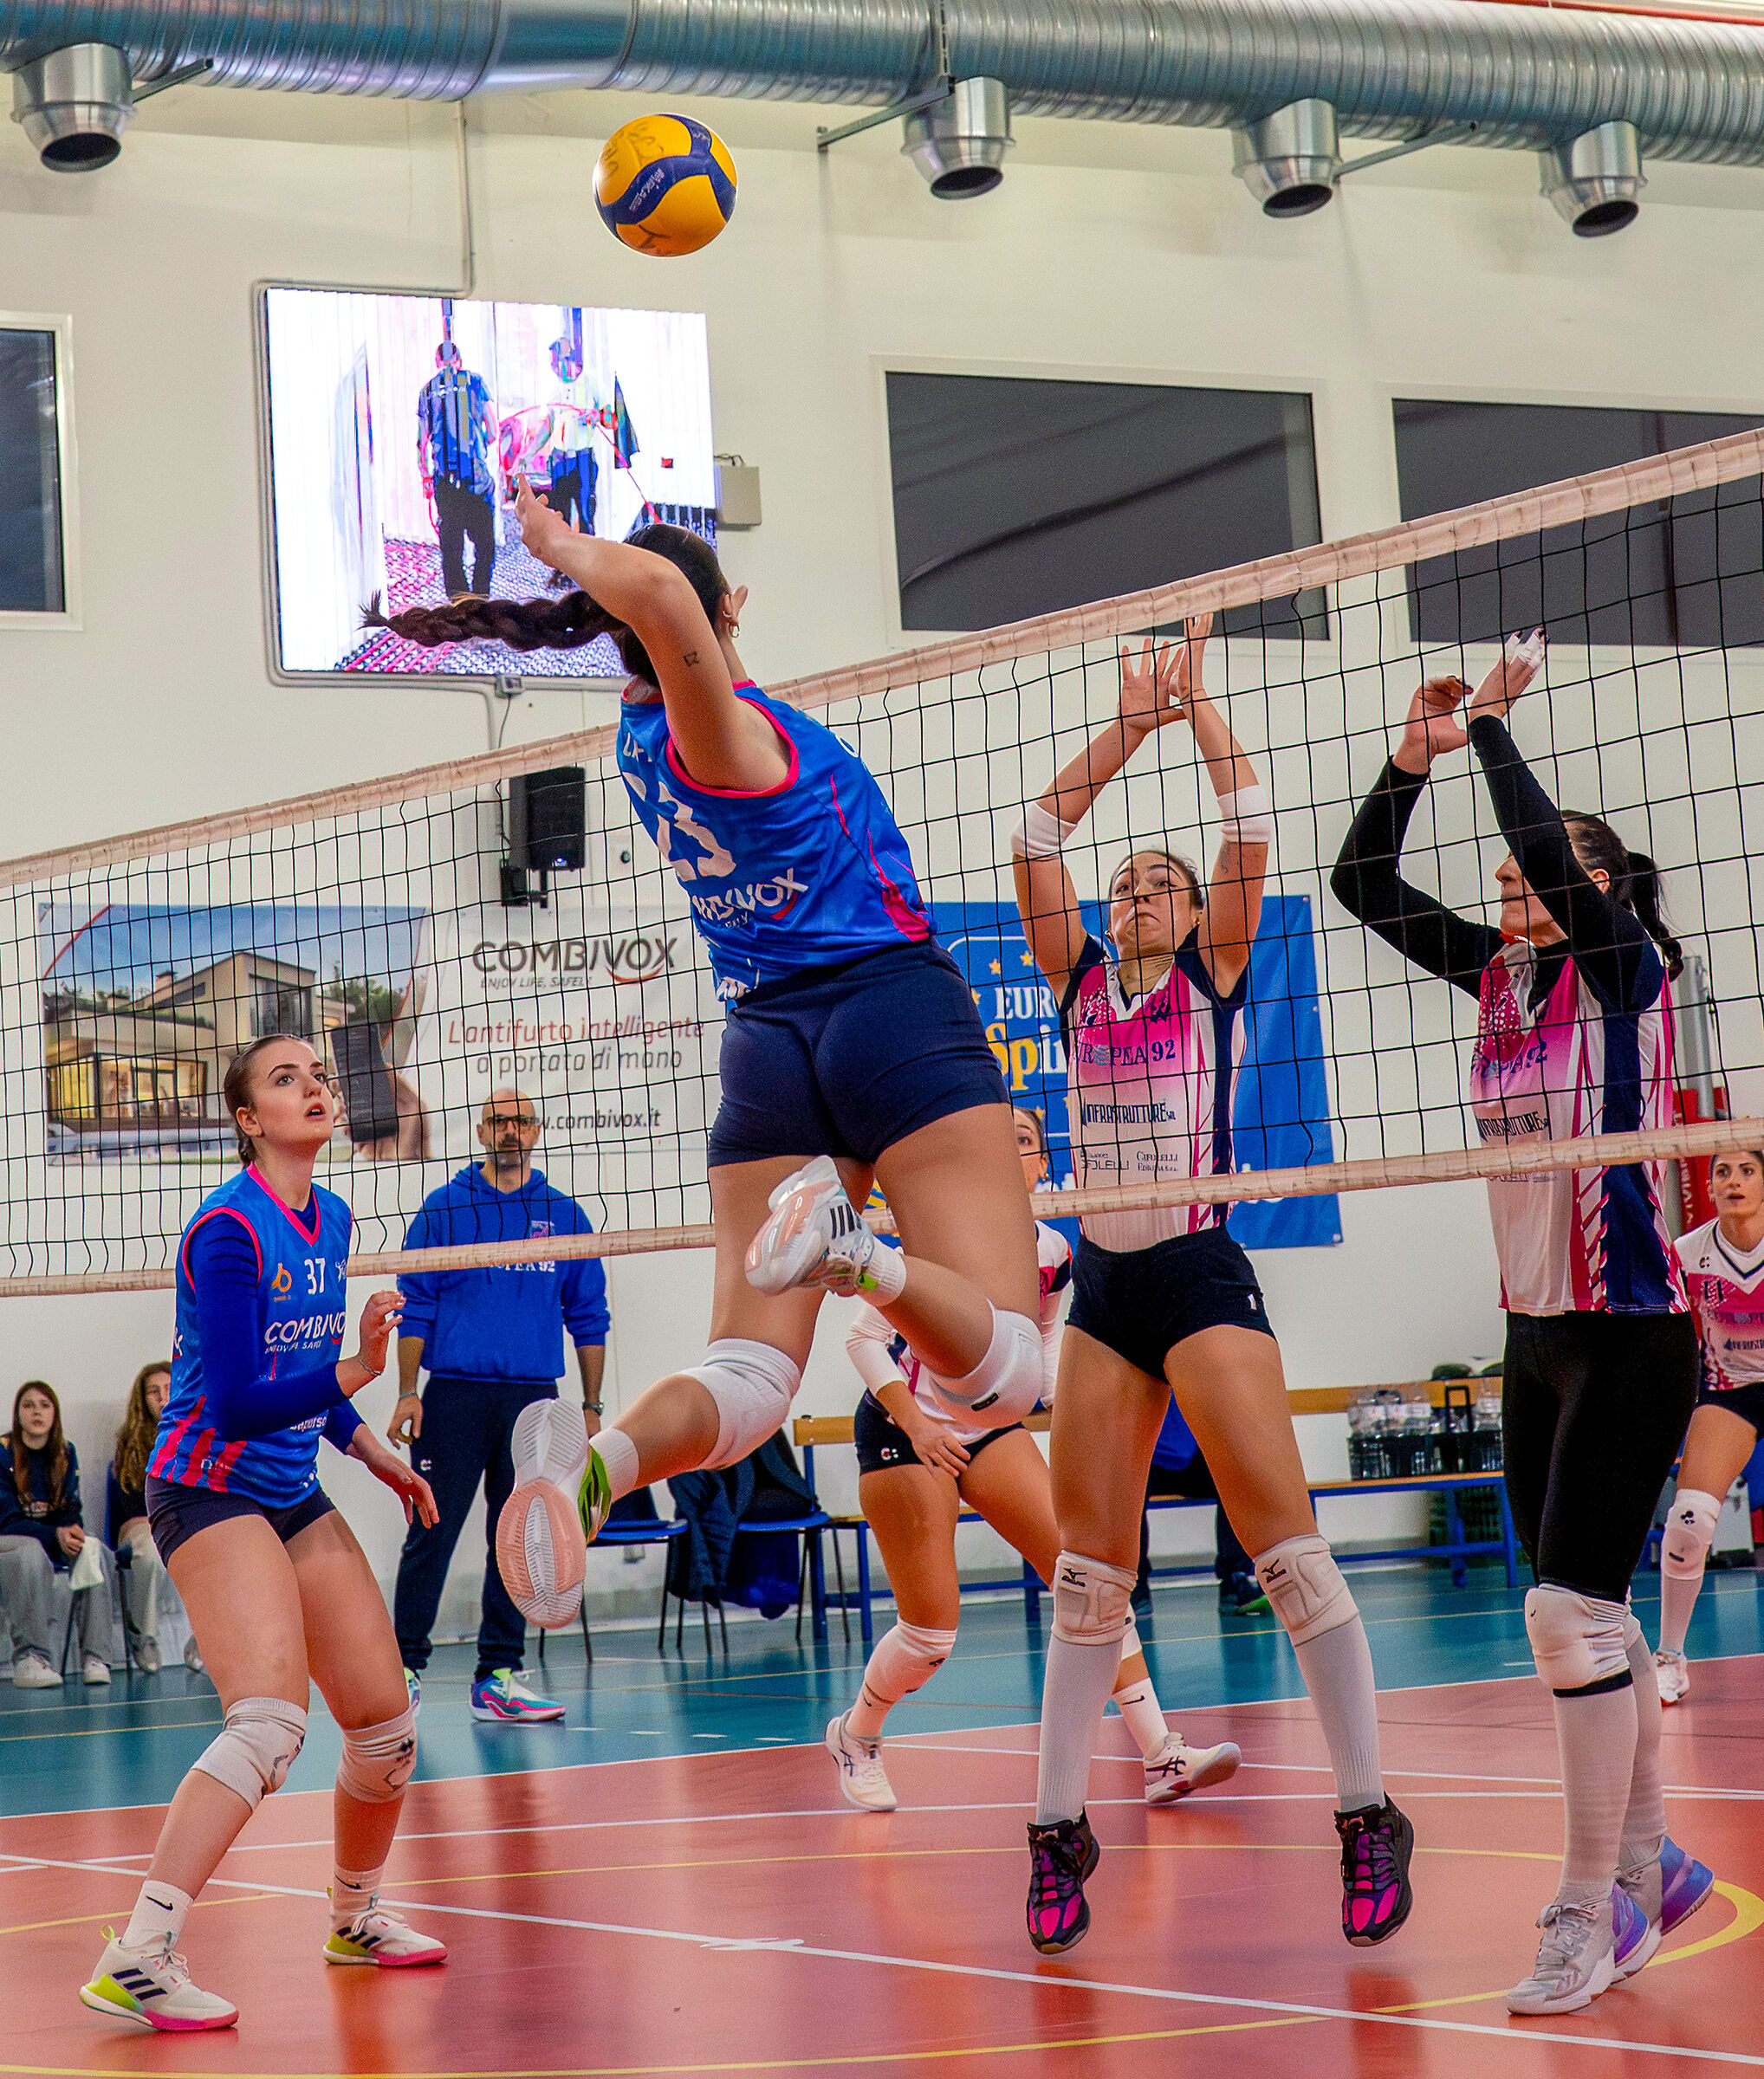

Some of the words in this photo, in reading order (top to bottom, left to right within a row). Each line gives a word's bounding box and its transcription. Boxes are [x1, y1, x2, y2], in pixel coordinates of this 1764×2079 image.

[472, 938, 678, 972] COMBIVOX
[550, 975, 593, 987] SAFEL
[994, 986, 1059, 1020] EUR
[580, 1014, 704, 1045] intelligente
[477, 1057, 489, 1073] a
[499, 1053, 586, 1080] portata
[593, 1046, 612, 1070] di
[619, 1050, 683, 1069] mano
[1151, 1040, 1176, 1062] 92
[1082, 1098, 1166, 1127] INFRASTRUTTURE
[304, 1257, 326, 1295] 37
[264, 1311, 347, 1344] COMBIVO
